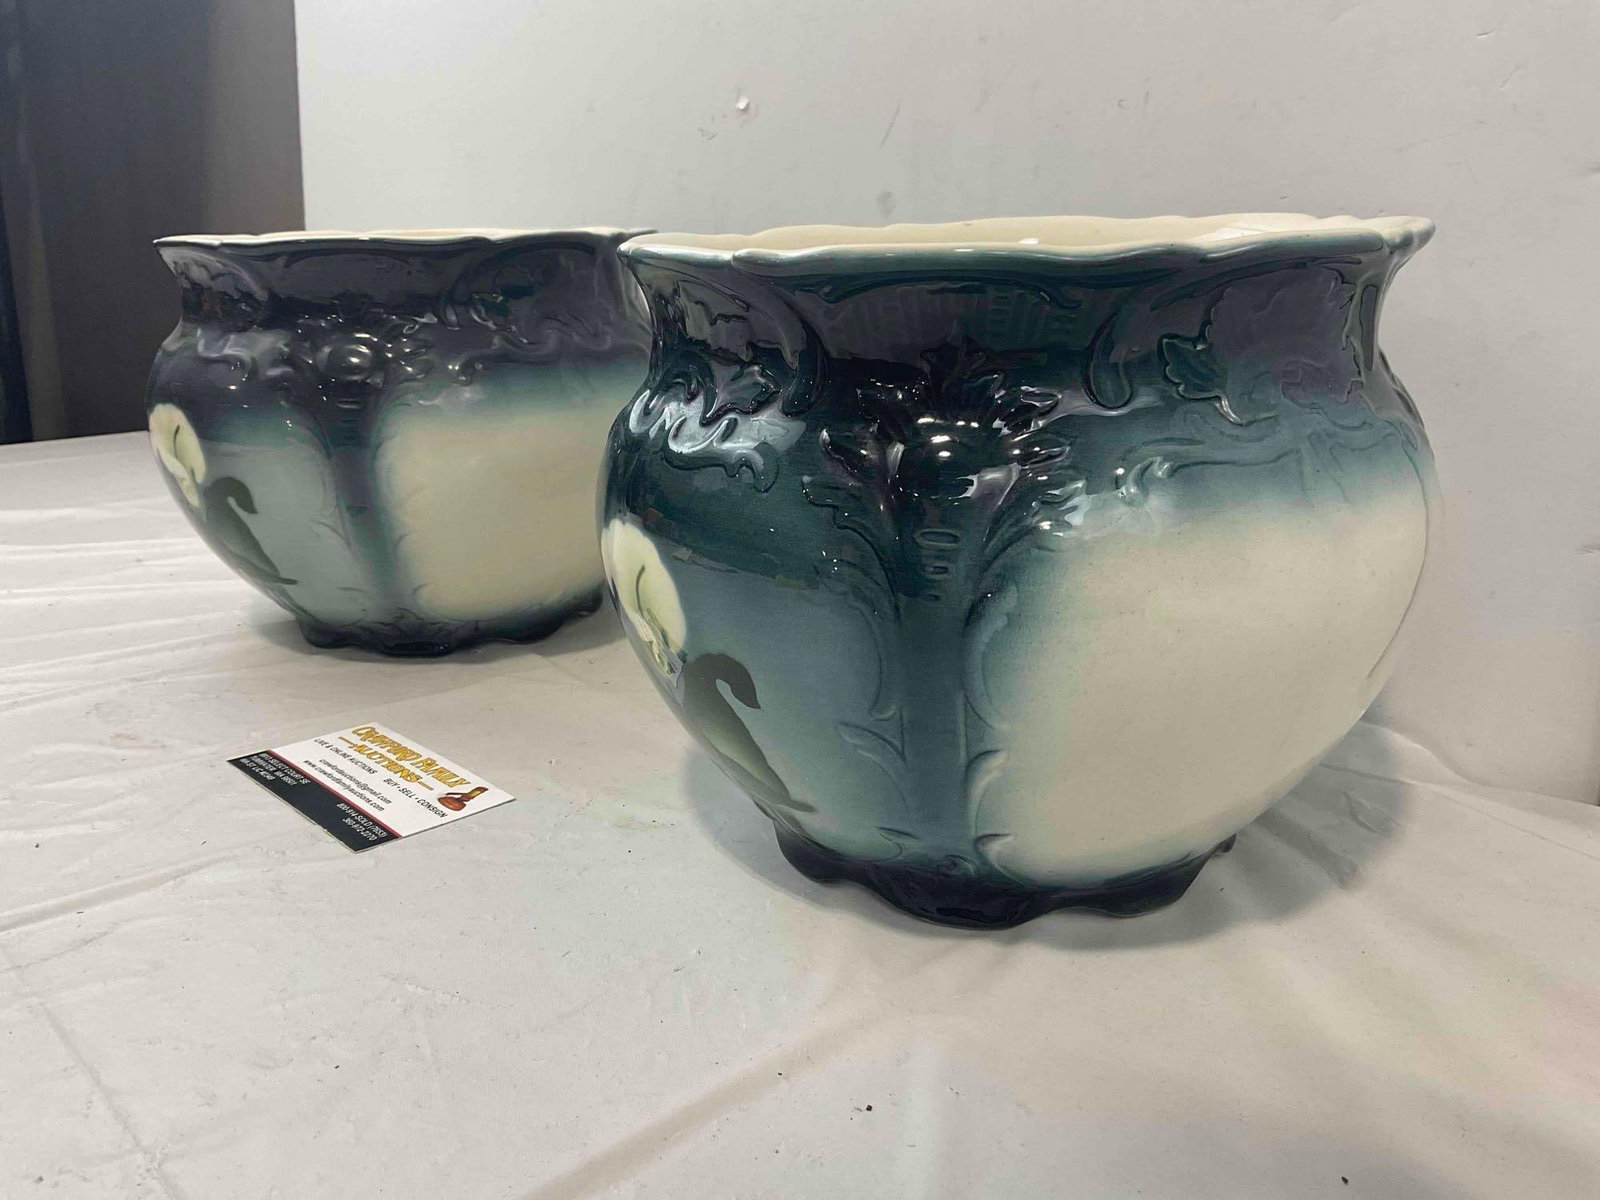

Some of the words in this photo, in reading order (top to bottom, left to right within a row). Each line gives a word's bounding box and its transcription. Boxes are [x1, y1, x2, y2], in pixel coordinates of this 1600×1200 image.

[347, 757, 377, 774] AUCTIONS
[349, 743, 424, 783] AUCTIONS
[408, 757, 472, 788] FAMILY
[382, 778, 399, 786] BUY
[398, 787, 418, 798] SELL
[415, 798, 448, 817] CONSIGN
